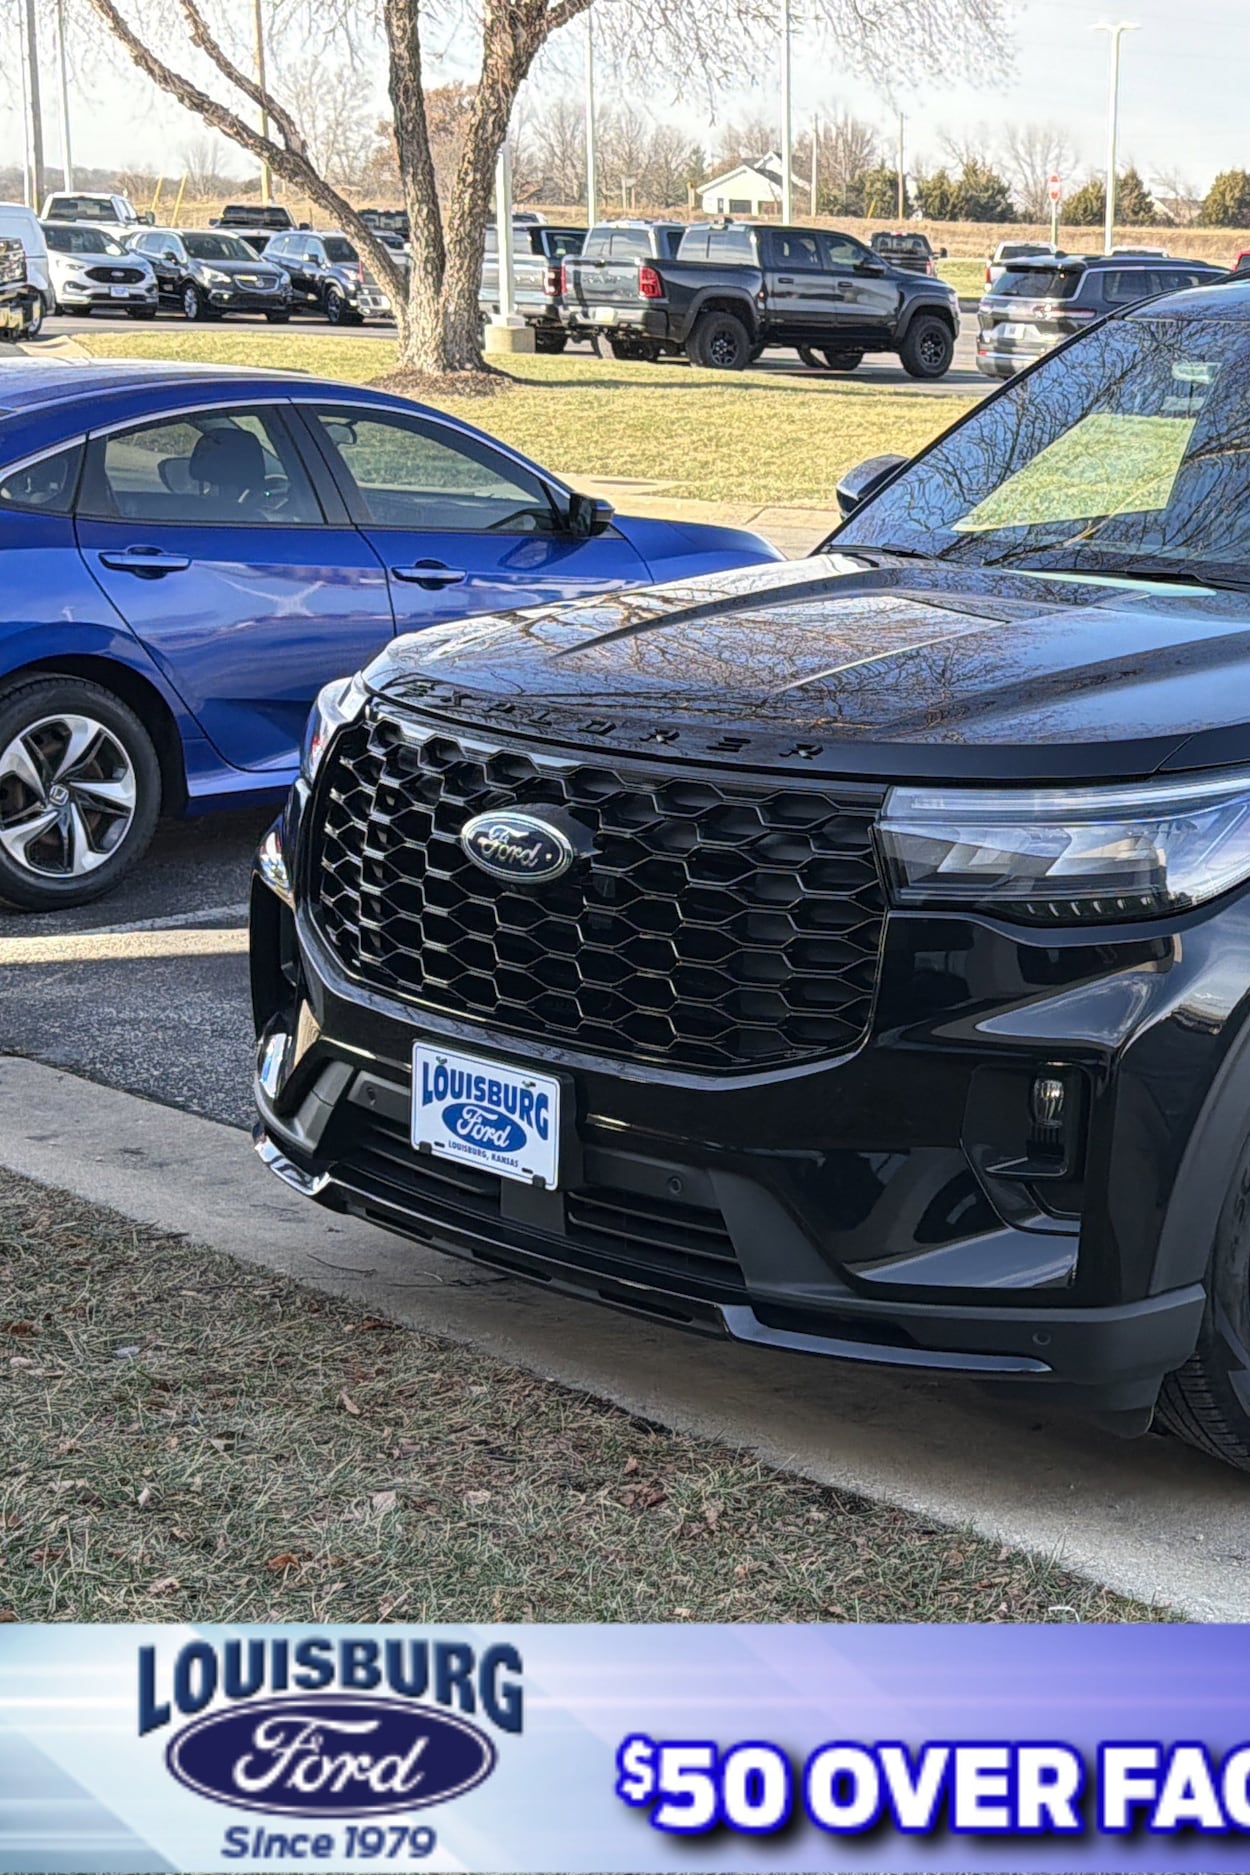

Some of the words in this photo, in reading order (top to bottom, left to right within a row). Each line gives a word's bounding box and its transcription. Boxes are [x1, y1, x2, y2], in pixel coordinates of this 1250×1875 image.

[477, 824, 543, 868] Ford
[422, 1061, 549, 1141] LOUISBURG
[456, 1106, 512, 1148] Ford
[448, 1139, 490, 1161] LOUISBURG,
[491, 1153, 519, 1169] KANSAS
